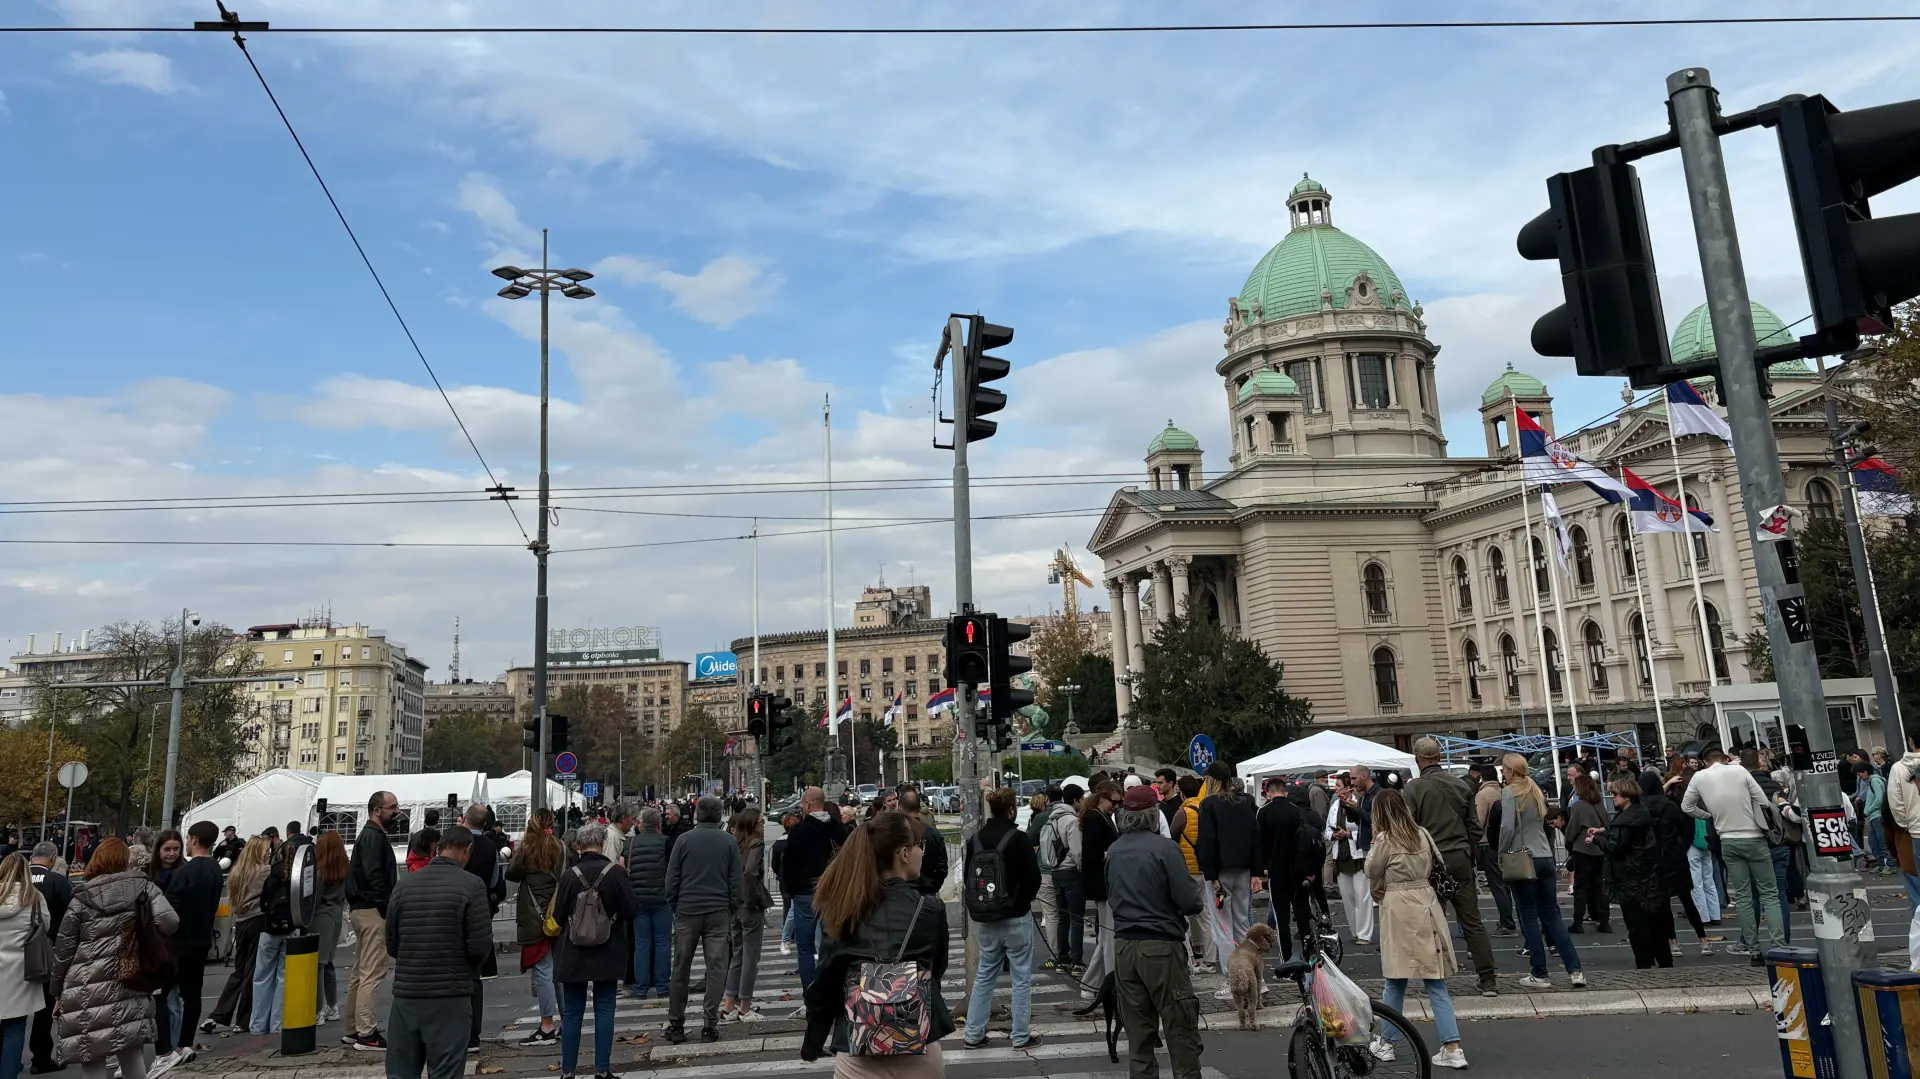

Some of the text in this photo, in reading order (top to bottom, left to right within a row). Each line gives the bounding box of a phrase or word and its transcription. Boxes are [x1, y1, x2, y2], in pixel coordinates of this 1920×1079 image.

[550, 625, 650, 649] HONOR
[1813, 816, 1848, 833] FCK
[1816, 831, 1851, 848] SNS
